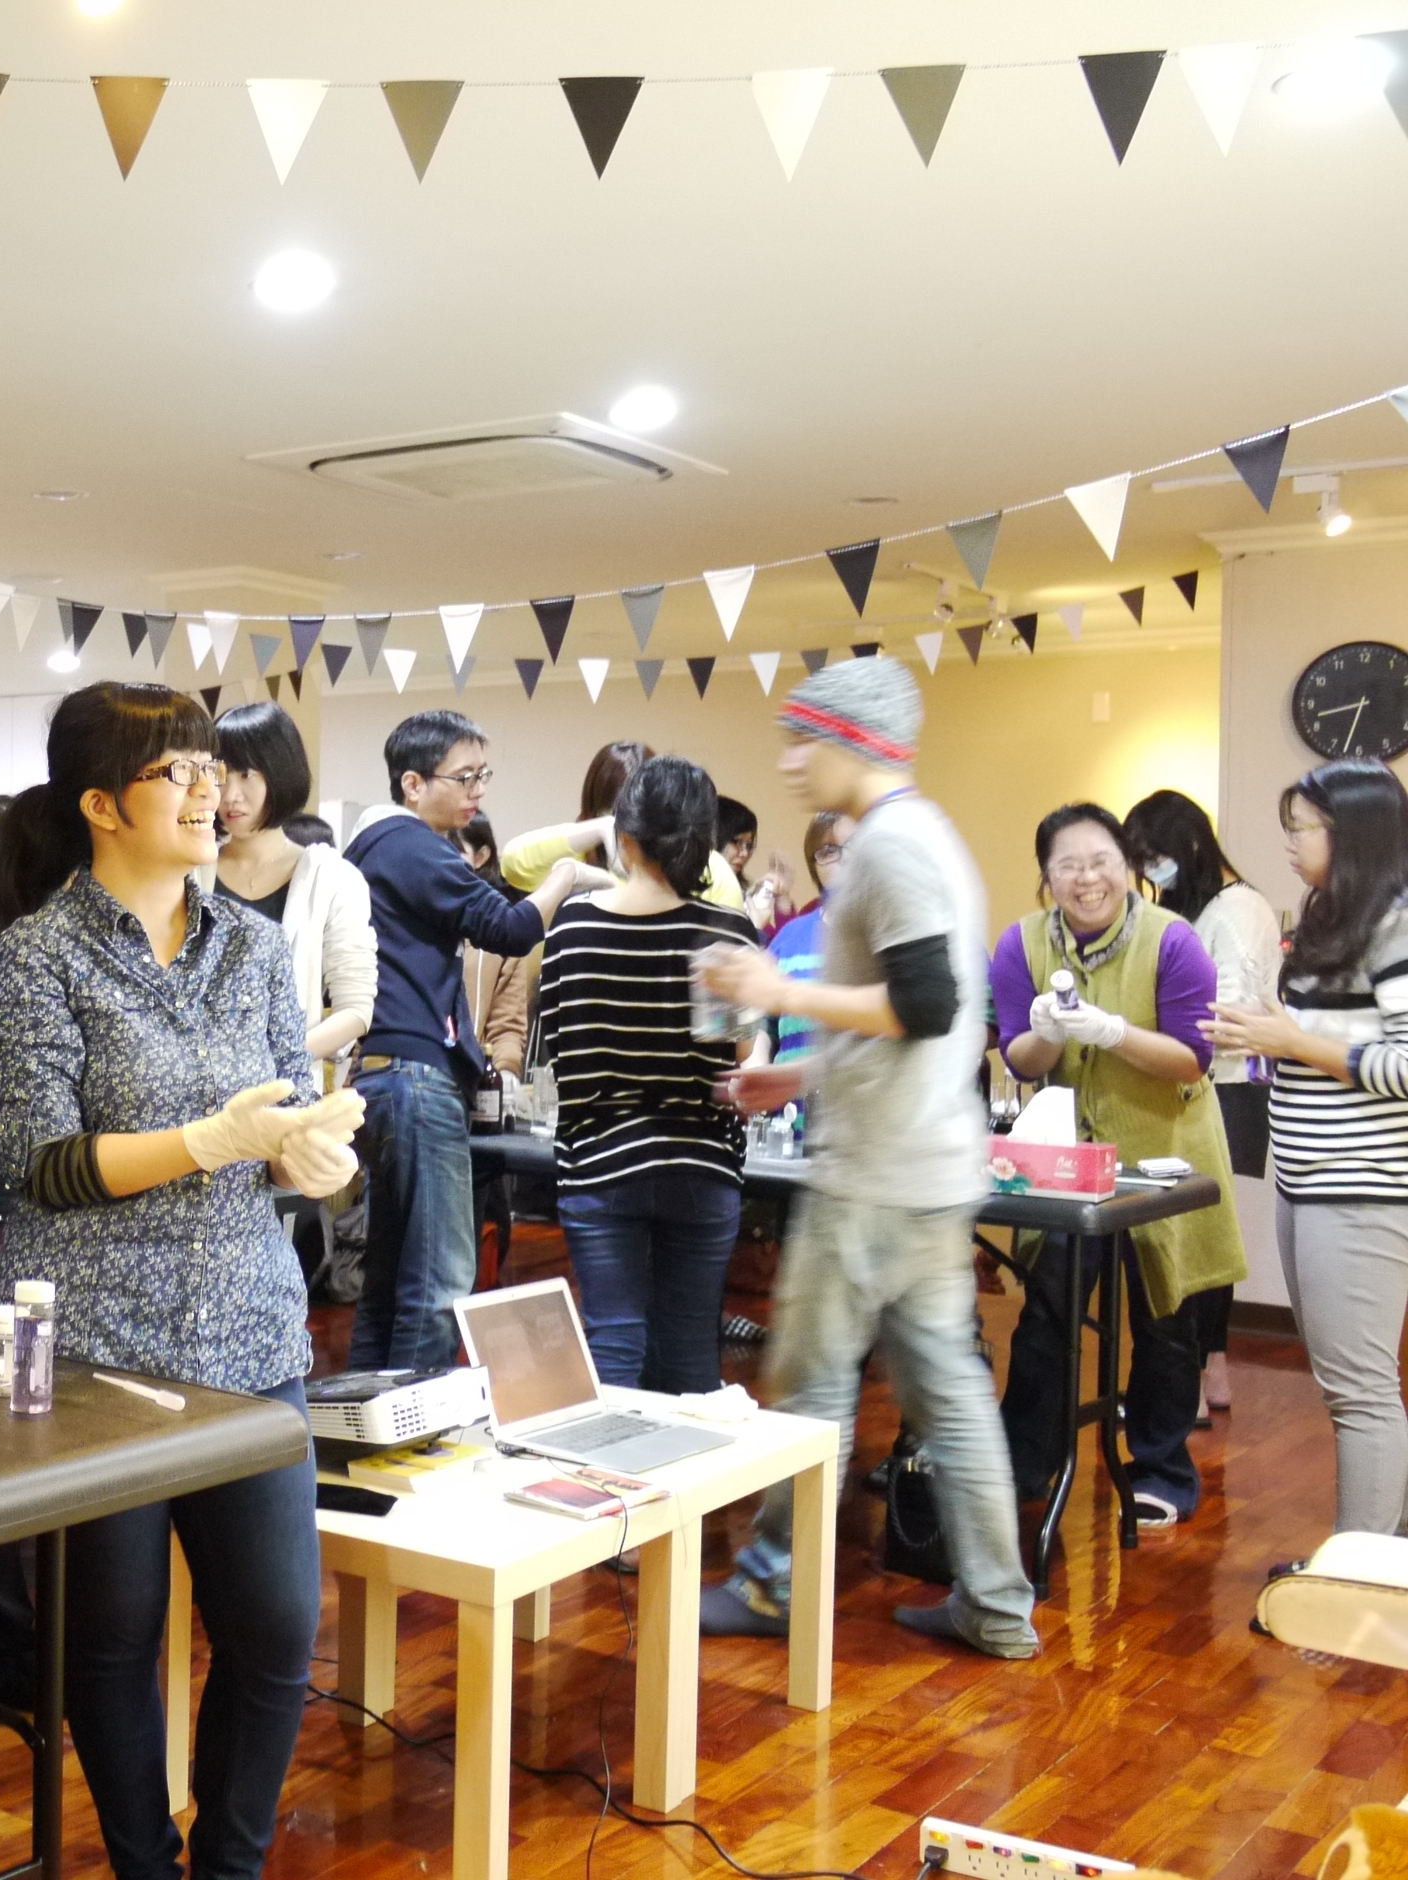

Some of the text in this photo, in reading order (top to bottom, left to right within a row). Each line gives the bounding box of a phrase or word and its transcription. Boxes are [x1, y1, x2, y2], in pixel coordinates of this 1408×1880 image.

[1360, 652, 1370, 663] 12
[1334, 660, 1344, 670] 11
[1316, 676, 1326, 687] 10
[1307, 700, 1314, 710] 9
[1313, 721, 1320, 732] 8
[1331, 738, 1338, 748] 7
[1382, 738, 1389, 749] 5
[1355, 745, 1363, 756] 6
